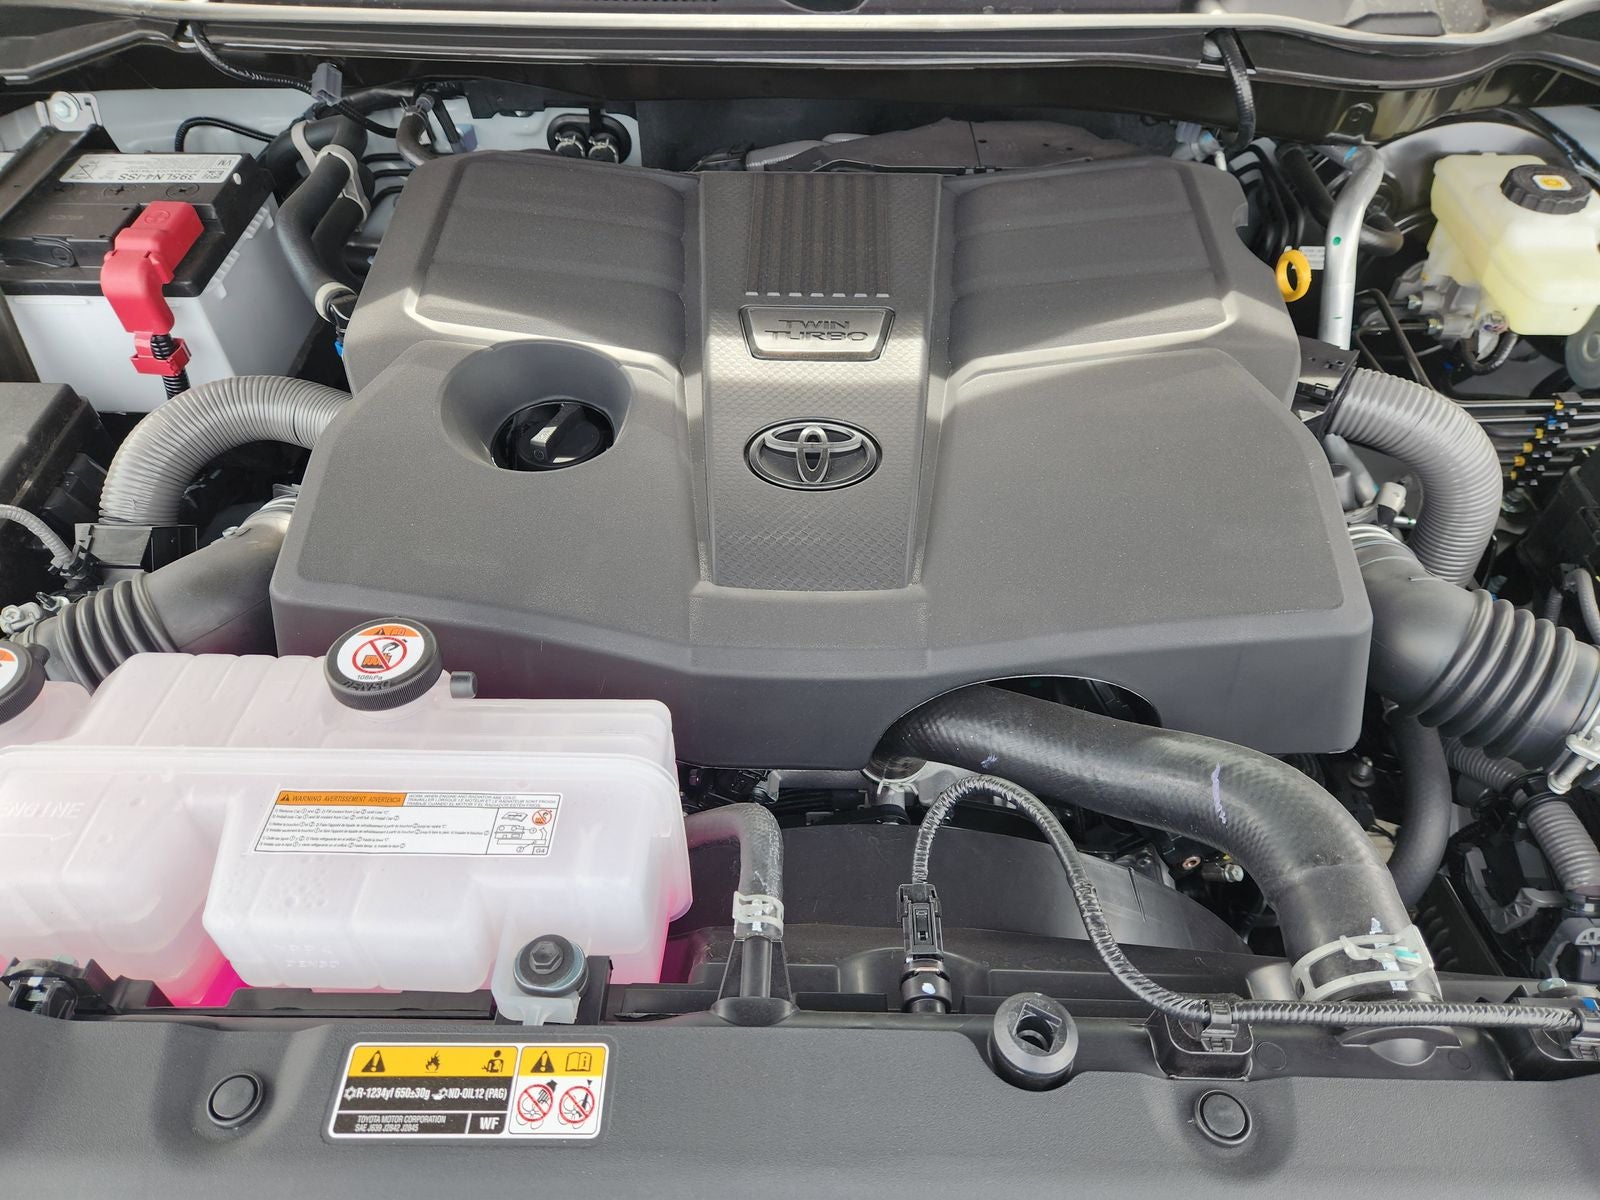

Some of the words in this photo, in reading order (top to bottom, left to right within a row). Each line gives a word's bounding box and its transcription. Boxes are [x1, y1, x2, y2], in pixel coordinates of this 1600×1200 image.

[778, 319, 849, 329] TWIN
[765, 330, 868, 340] TURBO
[357, 1087, 394, 1100] R-1234yf
[394, 1087, 430, 1100] 650±30g
[485, 1087, 507, 1101] (PAG)
[357, 1115, 380, 1123] TOYOTA
[381, 1115, 403, 1123] MOTOR
[404, 1115, 446, 1123] CORPORATION
[480, 1116, 500, 1130] WF
[355, 1123, 367, 1132] SAE
